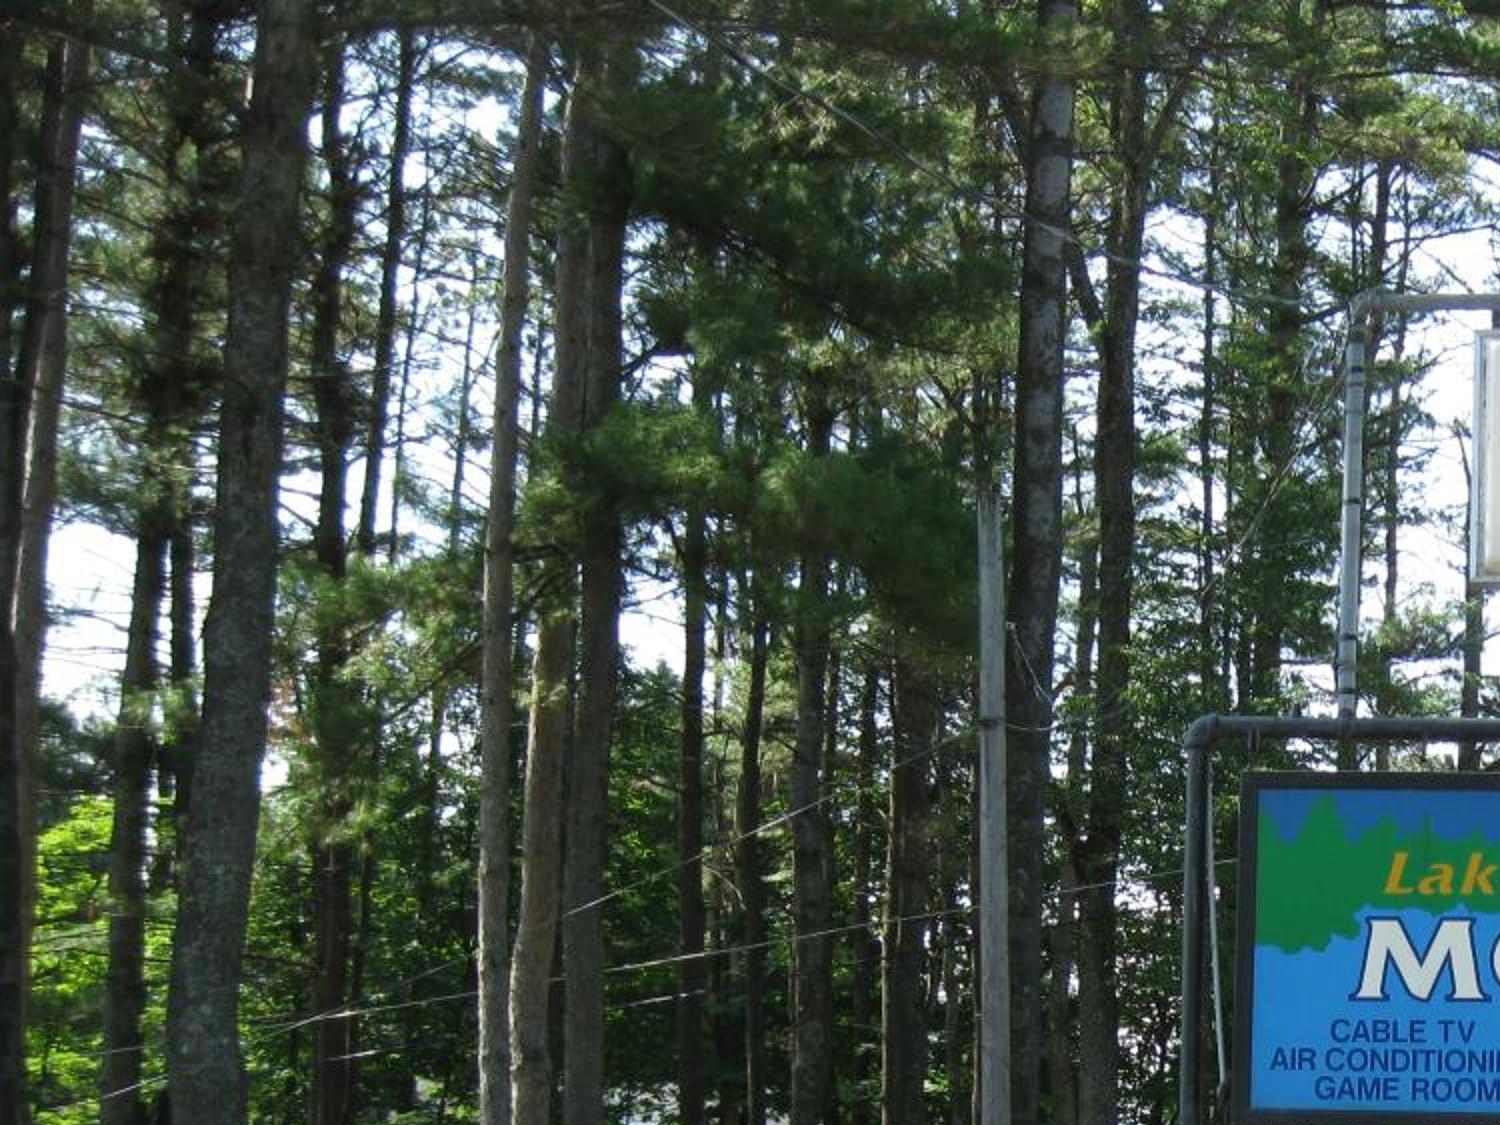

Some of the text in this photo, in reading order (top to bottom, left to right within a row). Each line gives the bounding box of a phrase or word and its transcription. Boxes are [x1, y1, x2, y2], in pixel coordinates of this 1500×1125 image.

[1331, 1020, 1476, 1044] CABLE TV
[1269, 1048, 1318, 1072] AIR
[1314, 1076, 1400, 1101] GAME
